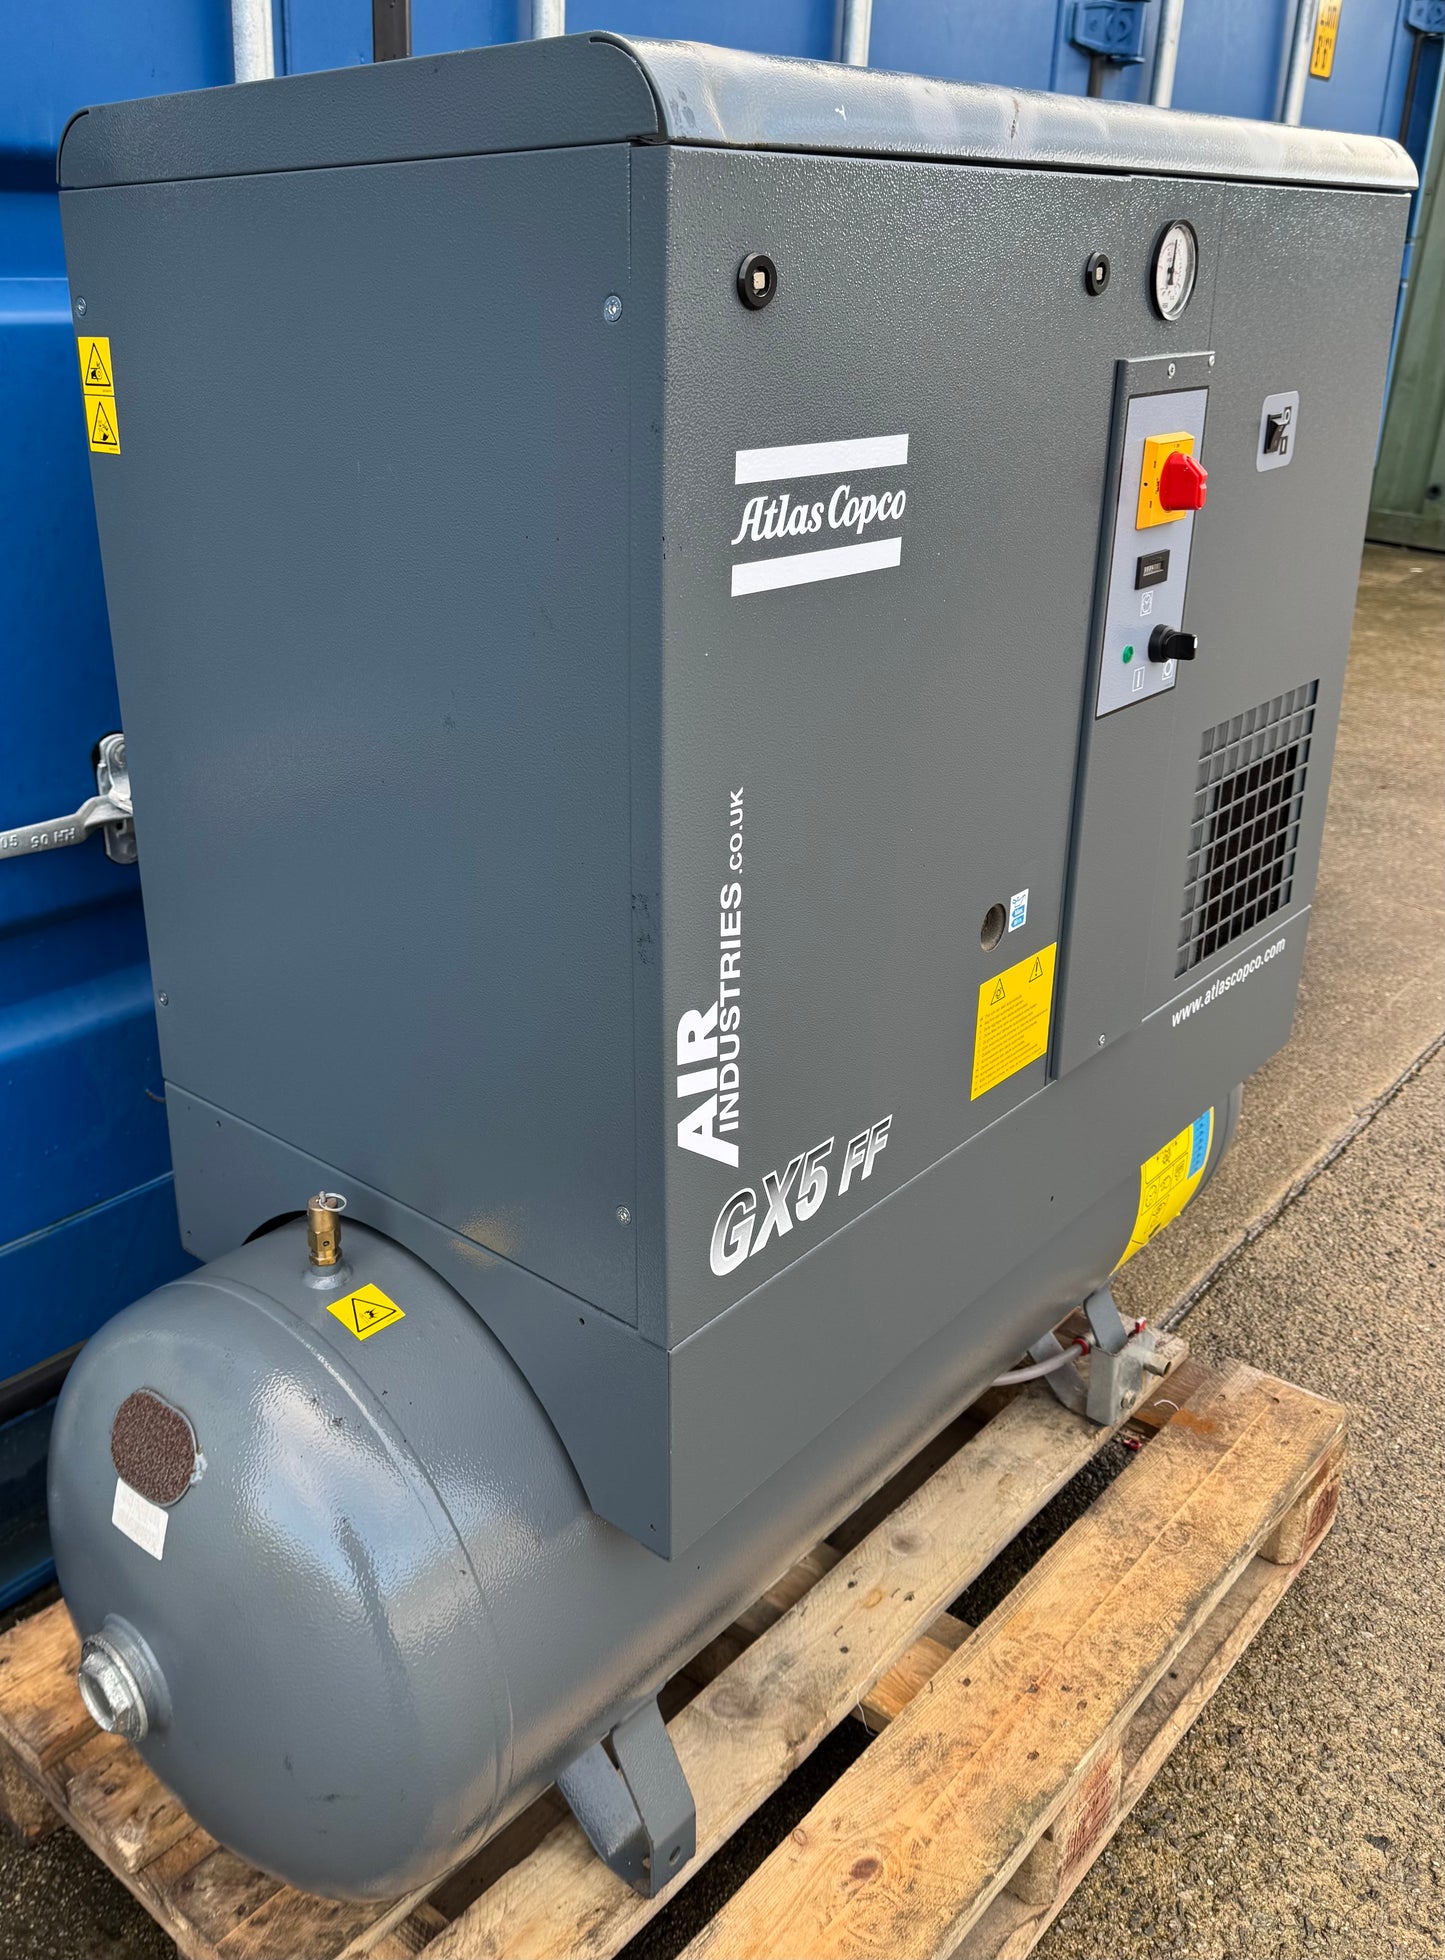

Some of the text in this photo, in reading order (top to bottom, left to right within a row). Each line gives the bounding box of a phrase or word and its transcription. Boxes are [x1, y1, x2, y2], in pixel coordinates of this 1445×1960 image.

[731, 485, 906, 545] Atlas Copco
[719, 786, 744, 1132] INDUSTRIES .CO.UK
[1172, 938, 1286, 1028] www.atlascopco.com
[677, 1001, 739, 1168] AIR
[710, 1114, 893, 1276] GX5 FF
